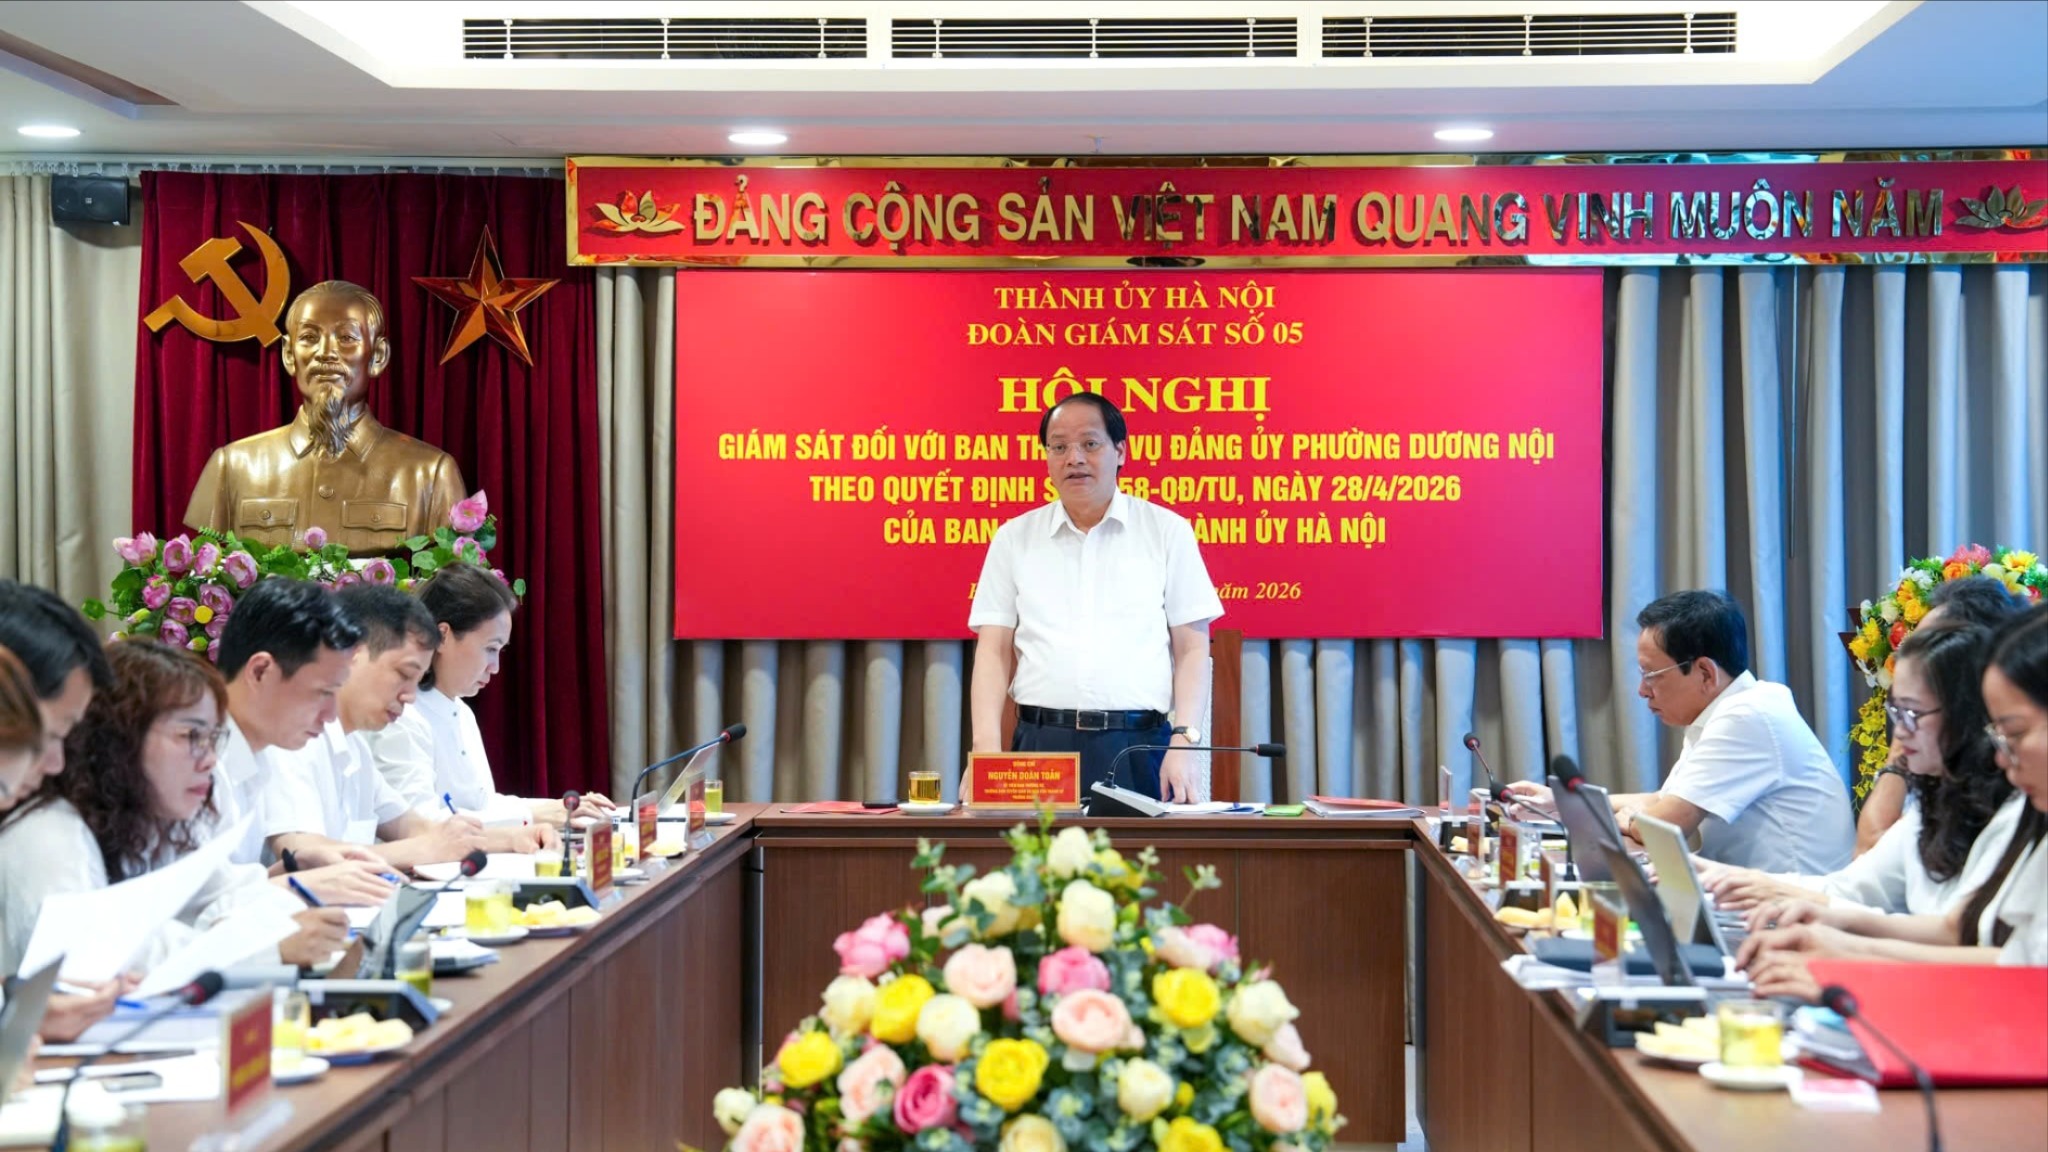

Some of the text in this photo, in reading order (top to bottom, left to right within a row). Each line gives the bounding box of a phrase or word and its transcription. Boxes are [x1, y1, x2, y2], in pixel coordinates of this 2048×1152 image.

[694, 174, 1943, 250] ĐẢNG CỘNG SẢN VIỆT NAM QUANG VINH MUÔN NĂM
[995, 280, 1275, 313] THÀNH ỦY HÀ NỘI
[967, 313, 1303, 345] ĐOÀN GIÁM SÁT SỐ 05
[1121, 376, 1271, 421] NGHỊ
[719, 428, 787, 460] GIÁM
[795, 428, 844, 461] SÁT
[851, 423, 896, 461] ĐỐI
[904, 429, 946, 461] VỚI
[955, 434, 1009, 460] BAN
[1129, 434, 1162, 467] VỤ
[1169, 426, 1243, 461] ĐẢNG
[1251, 426, 1285, 461] ỦY
[1293, 427, 1401, 460] PHƯỜNG
[1409, 430, 1500, 460] DƯƠNG
[1508, 427, 1555, 465] NỘI
[809, 476, 875, 502] THEO
[883, 468, 964, 504] QUYẾT
[971, 476, 1035, 509] ĐỊNH
[1253, 473, 1323, 502] NGÀY
[1331, 475, 1461, 502] 28/4/2026
[884, 509, 936, 544] CỦA
[945, 518, 999, 544] BAN
[1256, 510, 1288, 544] ỦY
[1297, 512, 1332, 543] HÀ
[1341, 511, 1386, 548] NỘI
[1255, 582, 1301, 600] 2026
